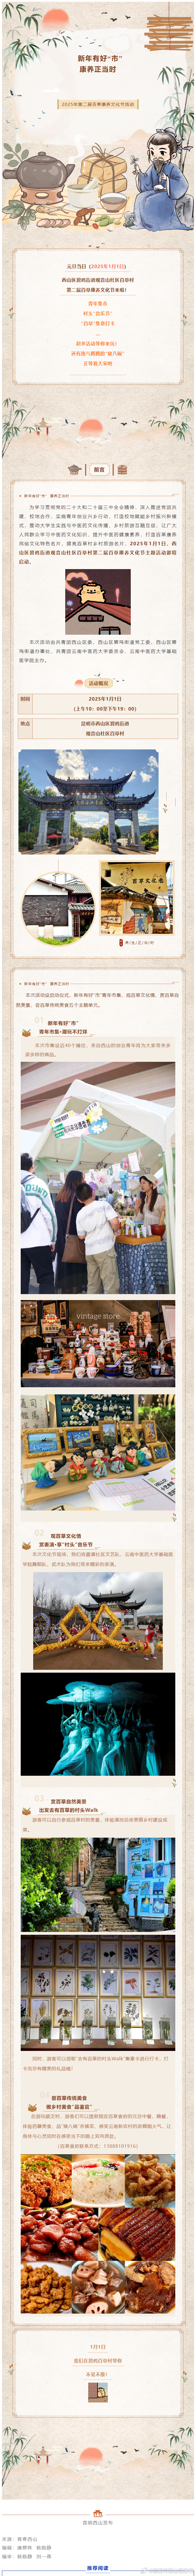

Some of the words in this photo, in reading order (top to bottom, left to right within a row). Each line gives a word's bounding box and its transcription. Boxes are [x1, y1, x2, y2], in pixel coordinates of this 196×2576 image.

[84, 1102, 97, 1116] 解压手工坊
[23, 1184, 48, 1198] OUND
[154, 1478, 168, 1487] HELLO!
[161, 1481, 175, 1491] 小艺术家
